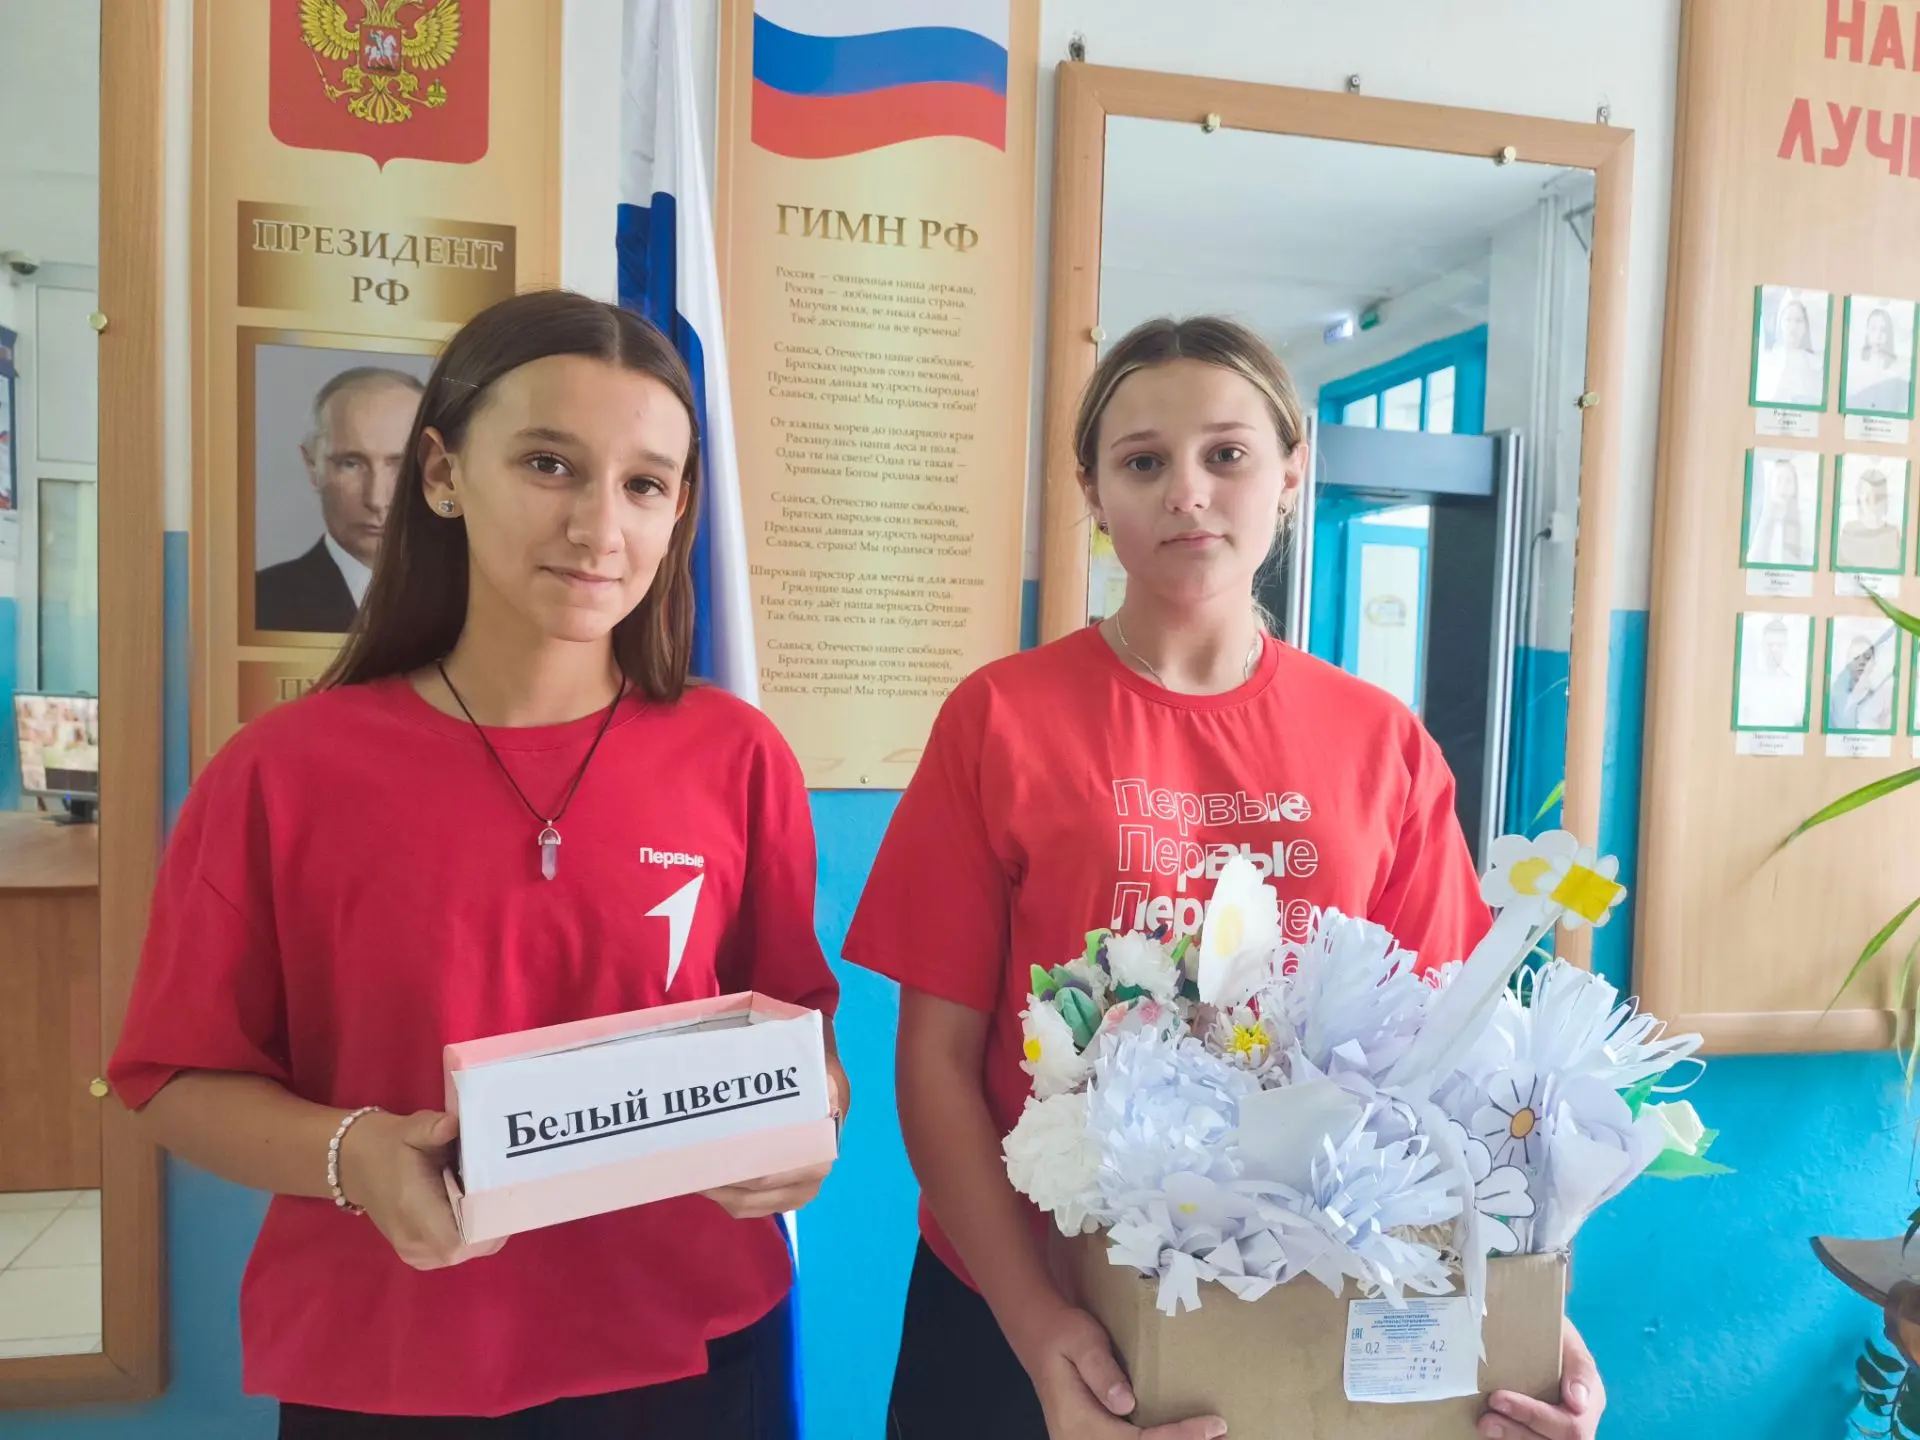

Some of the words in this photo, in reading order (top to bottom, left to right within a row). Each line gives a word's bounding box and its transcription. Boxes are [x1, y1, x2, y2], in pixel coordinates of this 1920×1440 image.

[1824, 0, 1920, 72] НА
[1776, 97, 1920, 180] ЛУЧ
[253, 219, 504, 270] ПРЕЗИДЕНТ
[774, 203, 908, 248] ГИМН
[919, 217, 980, 253] РФ
[350, 275, 410, 306] РФ
[1112, 778, 1312, 837] Первые
[639, 846, 705, 869] Первые
[1118, 823, 1319, 893] Первые
[1110, 881, 1315, 937] Пере
[503, 1087, 650, 1152] Белый
[661, 1065, 800, 1119] цветок
[1365, 1341, 1381, 1354] 0,2
